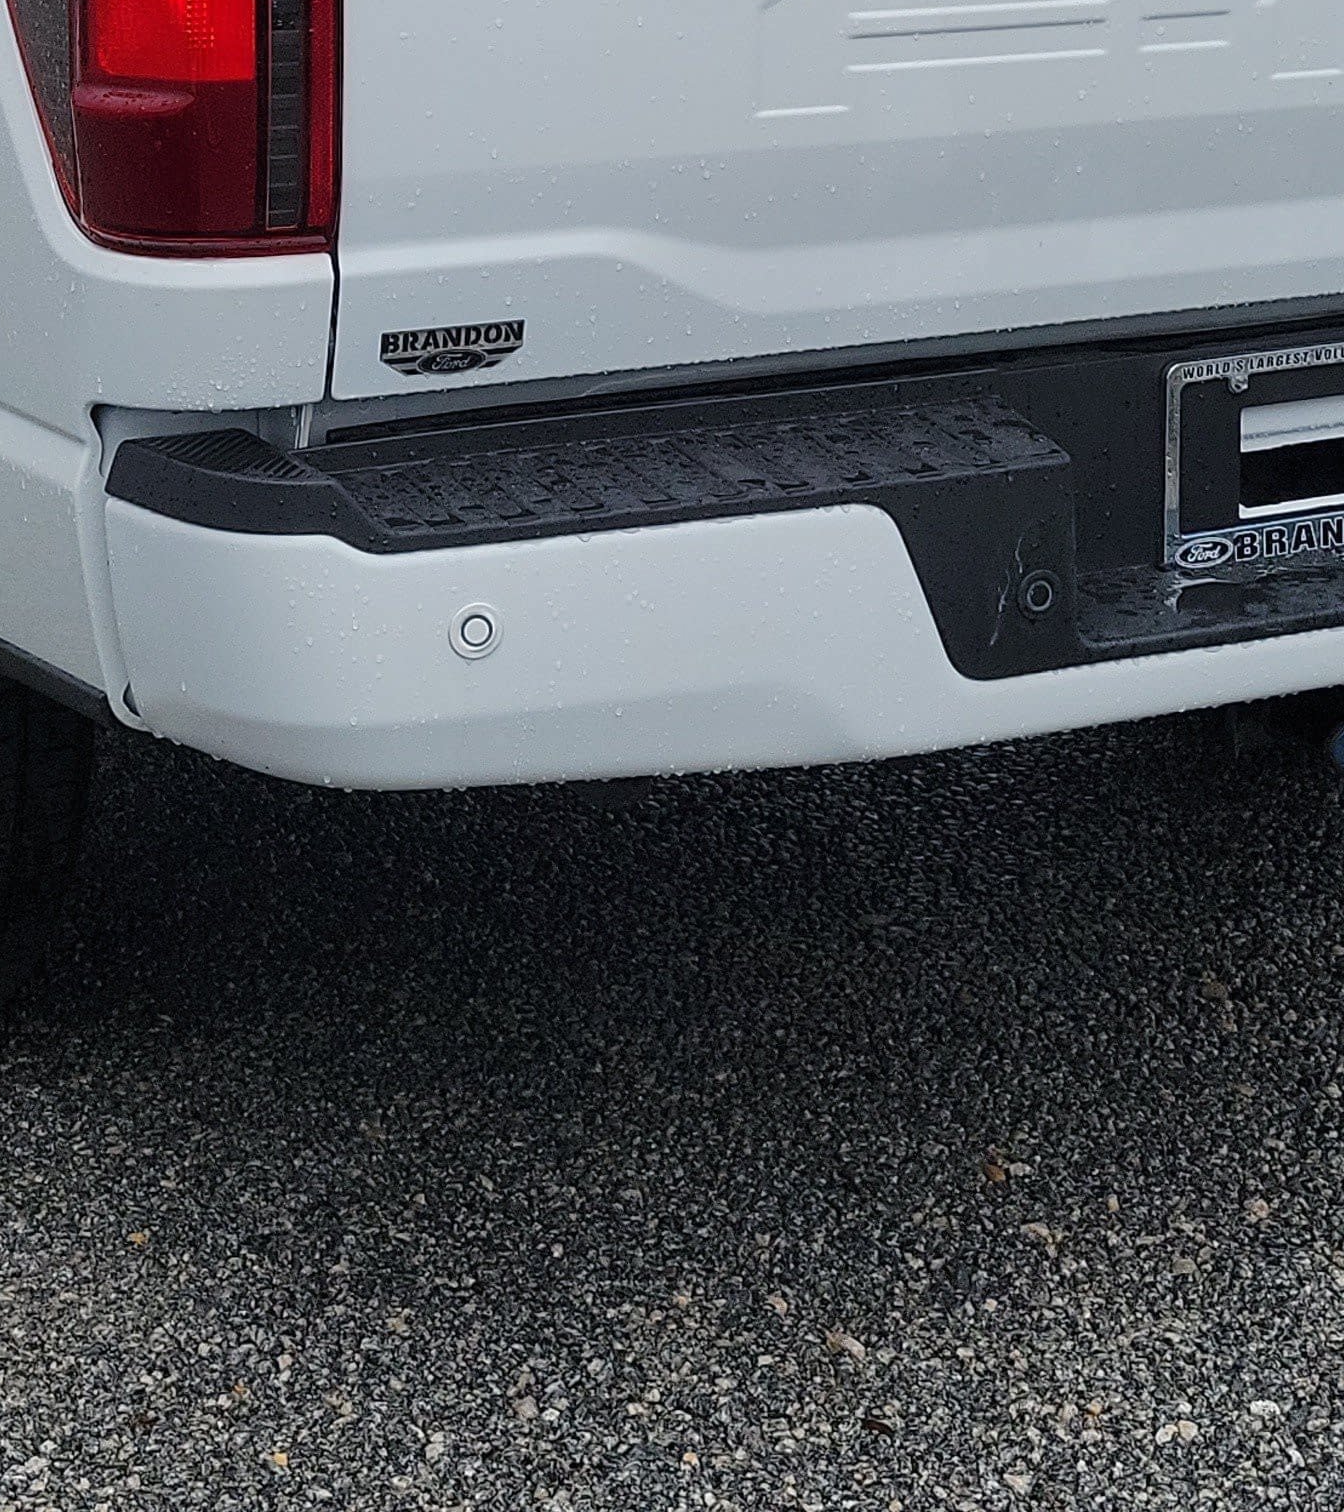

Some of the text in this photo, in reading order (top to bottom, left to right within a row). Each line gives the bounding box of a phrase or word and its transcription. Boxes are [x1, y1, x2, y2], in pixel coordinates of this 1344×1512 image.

[381, 320, 525, 355] BRANDON
[430, 352, 471, 370] Ford
[1248, 350, 1310, 371] LARGEST
[1187, 542, 1222, 563] Ford
